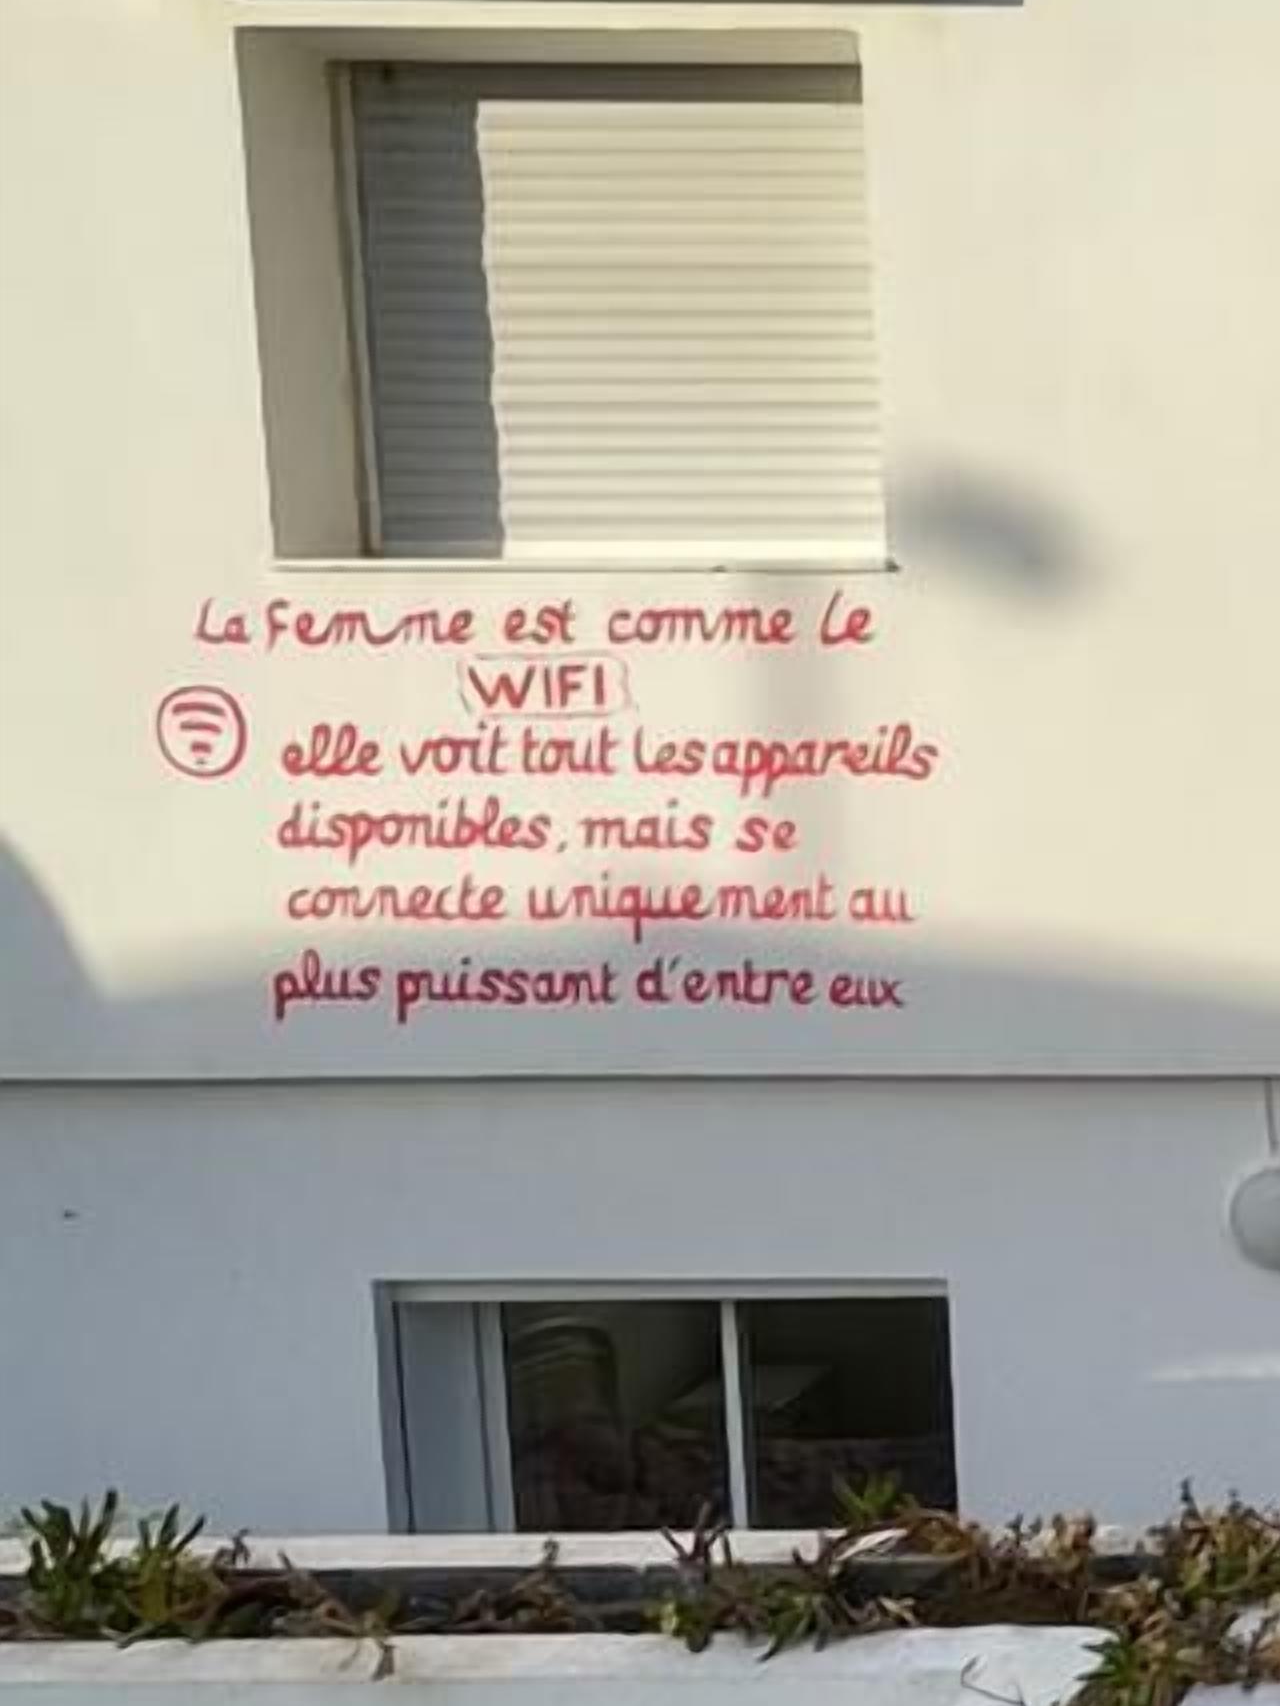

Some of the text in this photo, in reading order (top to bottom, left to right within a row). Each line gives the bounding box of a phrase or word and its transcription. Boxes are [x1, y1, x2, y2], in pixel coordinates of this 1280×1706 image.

[198, 597, 250, 643] La
[504, 600, 575, 644] est
[608, 607, 797, 644] comme
[467, 665, 605, 708] WIFI
[282, 721, 938, 796] elle voit tout les appareils
[278, 795, 797, 867] disponibles, mais se
[288, 873, 508, 920] connecte
[847, 889, 917, 923] au
[274, 948, 907, 1025] plus puissant d'entre eux
